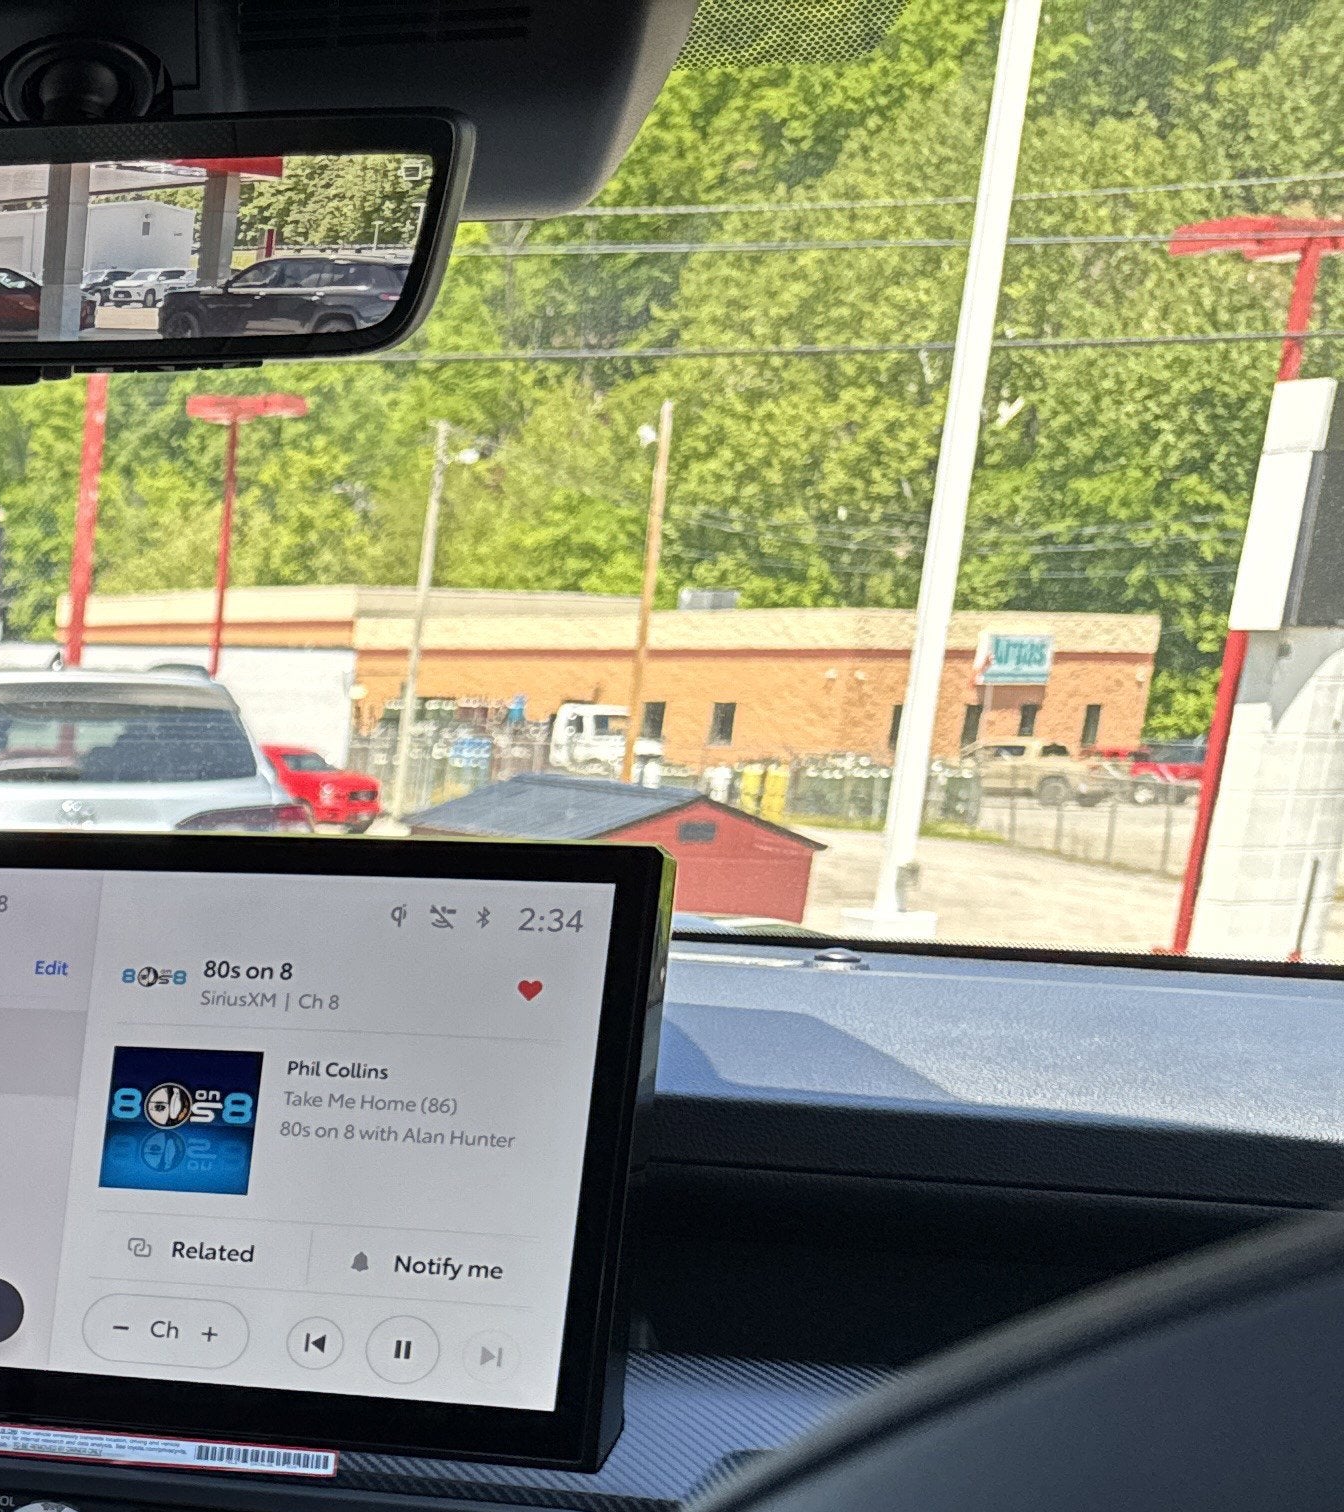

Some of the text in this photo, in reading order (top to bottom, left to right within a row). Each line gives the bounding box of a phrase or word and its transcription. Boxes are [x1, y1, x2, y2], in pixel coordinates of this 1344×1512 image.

[518, 907, 584, 933] 2:34
[35, 961, 69, 976] Edit
[203, 960, 293, 981] 80s on 8
[200, 990, 340, 1010] SiriusXM Ch 8
[287, 1061, 389, 1081] Phil Collins
[284, 1091, 458, 1115] Take Me Home (86)
[279, 1122, 516, 1149] 80s on 8 with Alan Hunter
[171, 1240, 255, 1264] Related
[394, 1255, 504, 1281] Notify me
[150, 1320, 180, 1340] Ch
